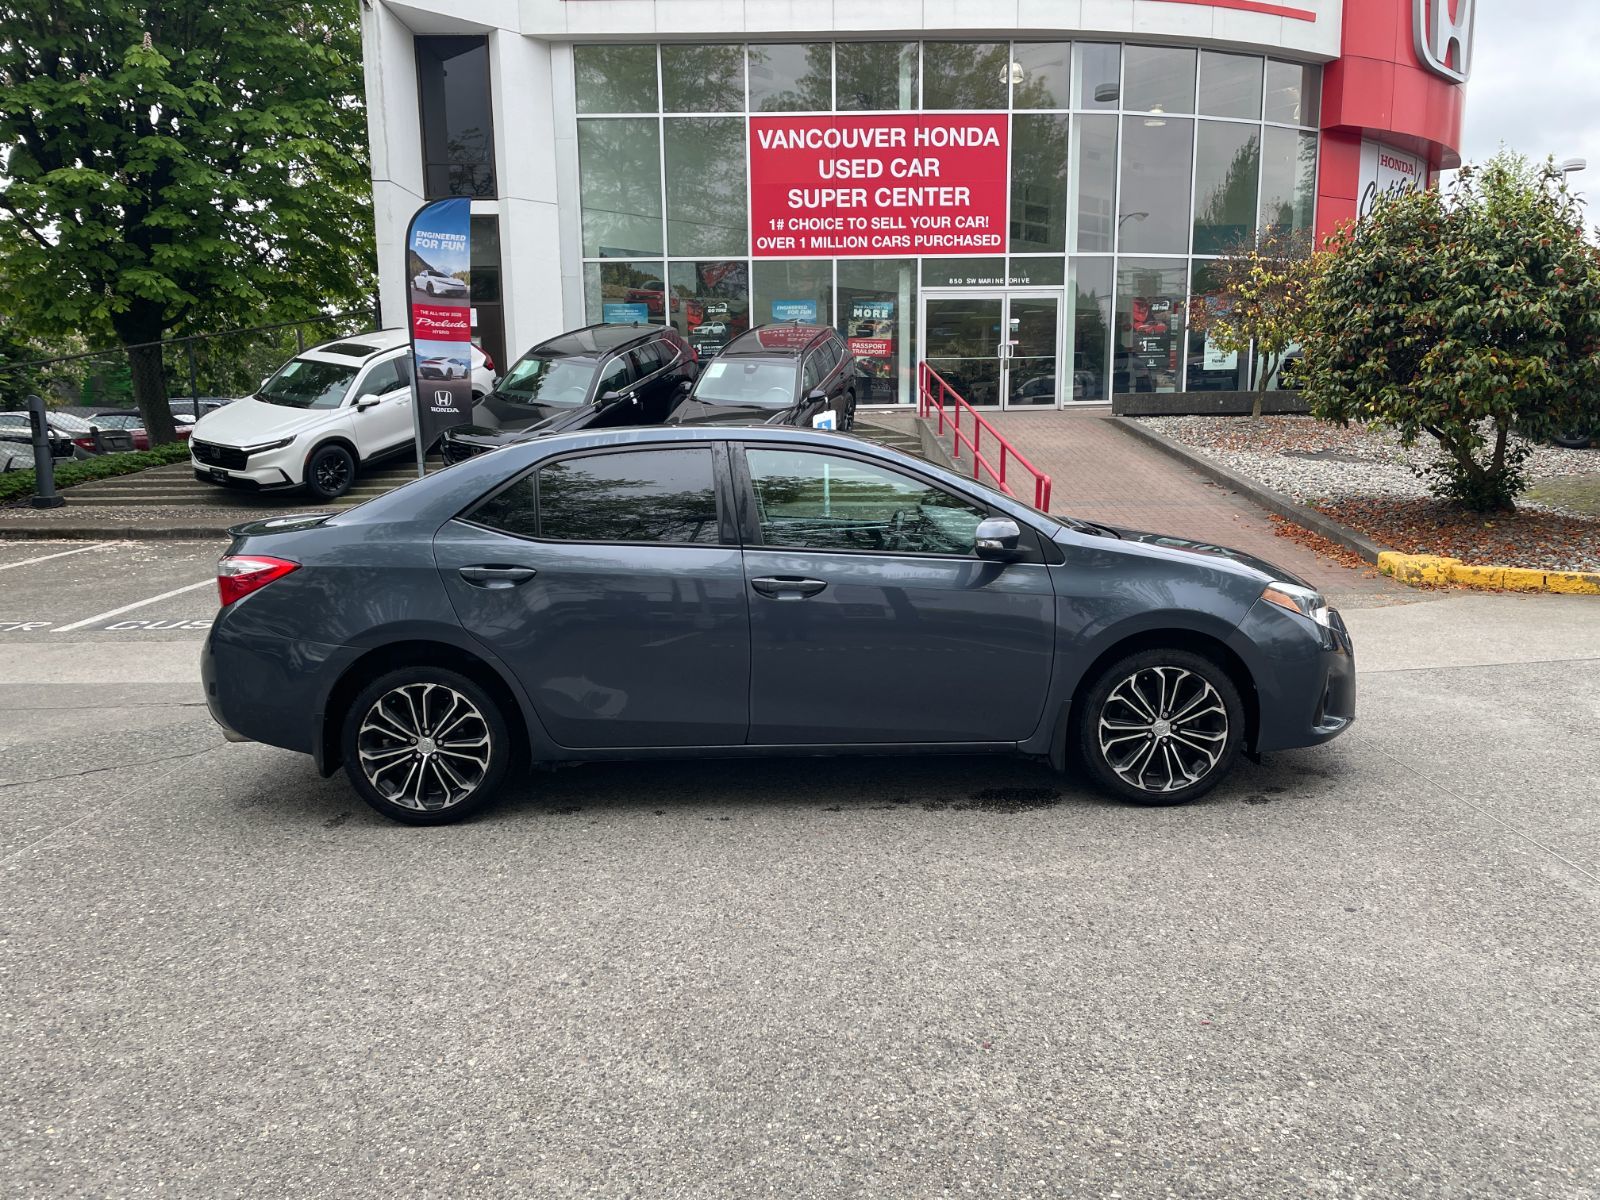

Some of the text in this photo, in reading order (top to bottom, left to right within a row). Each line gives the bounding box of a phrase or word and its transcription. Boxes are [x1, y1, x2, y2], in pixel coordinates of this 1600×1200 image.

[758, 127, 1000, 149] VANCOUVER HONDA
[818, 158, 940, 179] USED CAR
[1380, 154, 1414, 175] HONDA
[788, 187, 970, 208] SUPER CENTER
[769, 216, 989, 231] 1# CHOICE TO SELL YOUR CAR!
[416, 230, 466, 241] ENGINEERED
[757, 234, 1001, 249] OVER 1 MILLION CARS PURCHASED
[415, 238, 465, 251] FOR FUN
[853, 309, 888, 318] MORE
[416, 317, 468, 328] Prelude
